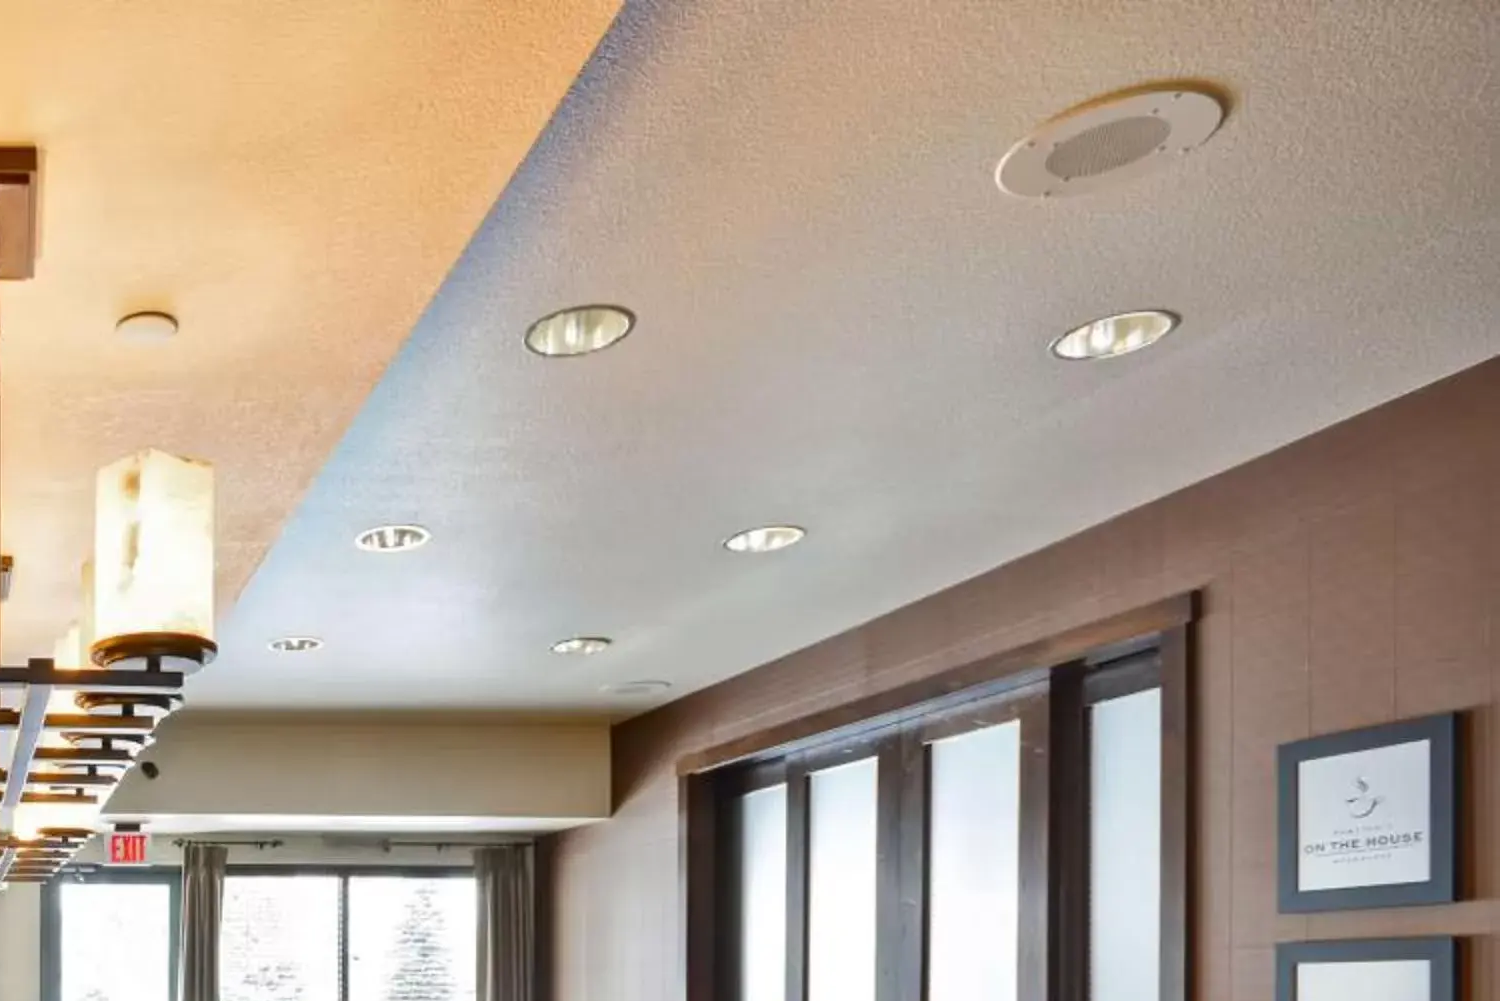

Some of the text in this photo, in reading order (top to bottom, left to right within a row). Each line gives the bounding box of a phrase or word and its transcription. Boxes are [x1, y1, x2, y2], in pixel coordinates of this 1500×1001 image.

[111, 834, 147, 863] EXIT
[1303, 831, 1424, 855] ON THE HOUSE
